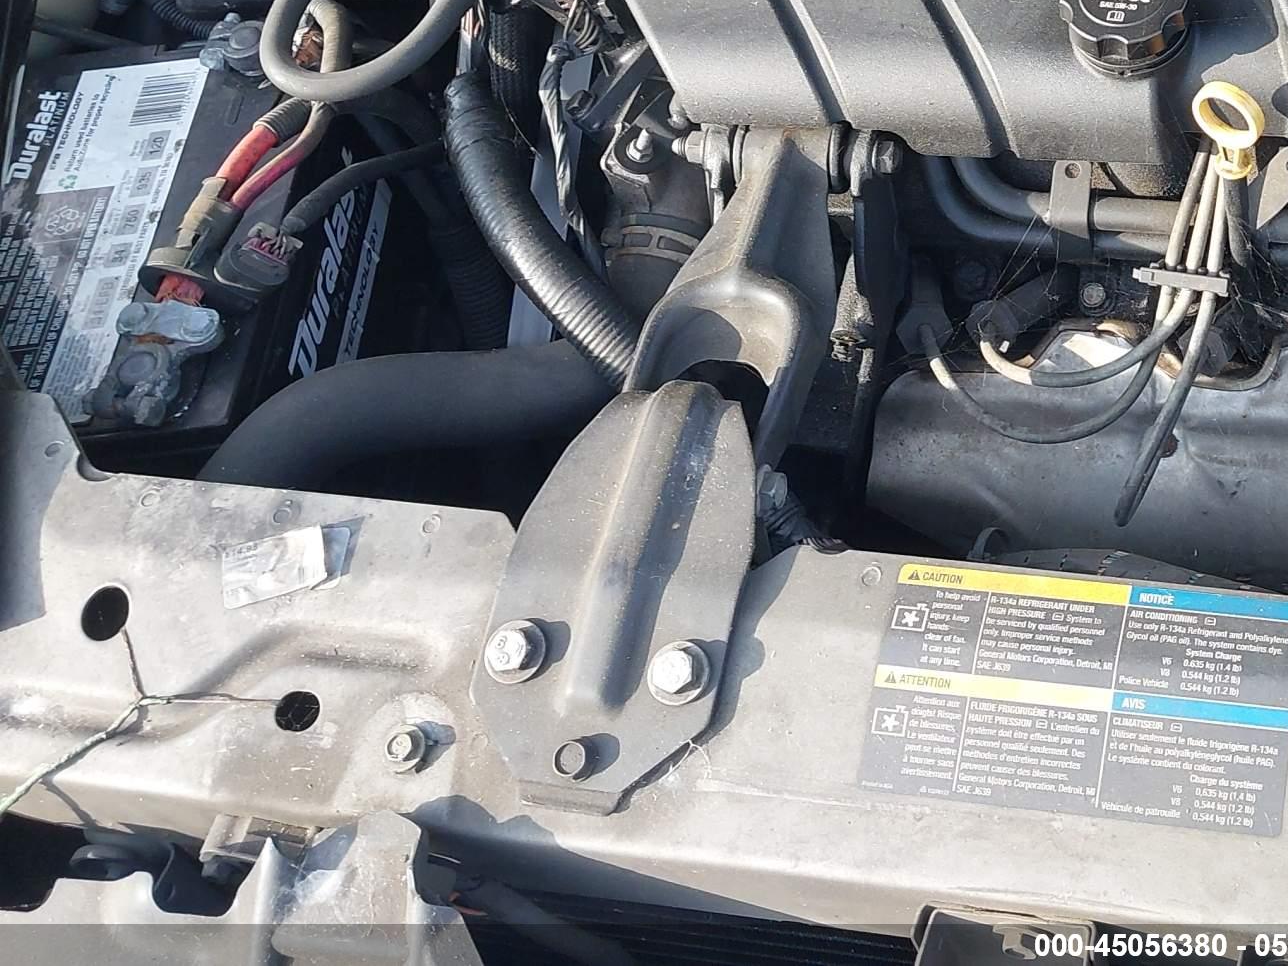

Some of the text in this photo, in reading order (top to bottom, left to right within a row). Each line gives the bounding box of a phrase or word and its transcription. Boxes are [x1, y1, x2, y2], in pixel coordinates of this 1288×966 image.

[43, 91, 71, 147] PLATINUM
[57, 91, 84, 150] TECHNOLOGY
[4, 90, 61, 184] Duralast
[63, 149, 79, 172] Return
[75, 131, 85, 148] used
[81, 104, 97, 131] batteries
[73, 138, 91, 172] AutoZone
[86, 128, 96, 139] for
[91, 107, 104, 130] proper
[149, 136, 165, 155] 120
[137, 171, 152, 191] 935
[288, 189, 355, 379] Duralas
[922, 572, 963, 584] CAUTION
[943, 591, 980, 601] help avoid
[990, 595, 1095, 613] R-134a REFRIGERANT UNDER
[1139, 593, 1174, 605] NOTICE
[931, 601, 963, 611] personal
[951, 613, 970, 623] keep
[987, 606, 1006, 615] HIGH
[1007, 608, 1046, 619] PRESSURE
[1065, 614, 1092, 625] System
[1130, 610, 1198, 623] AIR CONDITIONING
[985, 617, 1105, 637] be serviced by qualified personnel
[1128, 620, 1288, 645] Use only R-134a Refrigerant and Polyalkylene
[924, 632, 951, 642] clear of
[1000, 629, 1093, 645] Improper service methods
[1126, 631, 1148, 642] Glycol
[1159, 635, 1177, 644] (PAG
[1194, 638, 1207, 647] The
[1208, 640, 1234, 651] system
[1235, 643, 1266, 653] contains
[1268, 645, 1283, 656] dye.
[928, 643, 960, 654] can start
[980, 639, 1051, 653] may cause personal
[919, 655, 942, 665] at any
[978, 649, 1102, 670] General Motors Corporation, Detroit,
[1185, 648, 1241, 662] System Charge
[976, 660, 1011, 671] SAE J639
[1183, 659, 1242, 673] 0.635 kg (1.4 lb)
[899, 674, 951, 688] ATTENTION
[1181, 670, 1240, 684] 0.544 kg (1.2 lb)
[1118, 675, 1239, 696] Police Vehicle 0.544 kg (1.2 lb)
[1122, 697, 1145, 709] AVIS
[968, 713, 1100, 735] HAUTE PRESSION du
[1047, 710, 1098, 723] R-134a SOUS
[1112, 717, 1163, 730] CLIMATISEUR
[964, 737, 1086, 758] personnel Des
[1138, 732, 1278, 755] seulement le R-134a
[1108, 741, 1117, 749] et
[1118, 742, 1128, 750] de
[1129, 743, 1152, 753] l'huile
[1255, 757, 1274, 768] PAG).
[1016, 767, 1030, 776] des
[1107, 753, 1226, 774] Le système contient du colorant.
[956, 785, 971, 794] SAE
[973, 786, 991, 796] J639
[958, 773, 1085, 795] General Motors Corporation, Detroit,
[1189, 775, 1262, 791] Charge du système
[1218, 790, 1256, 802] kg lb)
[1100, 801, 1253, 827] Véhicule de patrouille kg lb)
[1216, 802, 1254, 815] kg lb)
